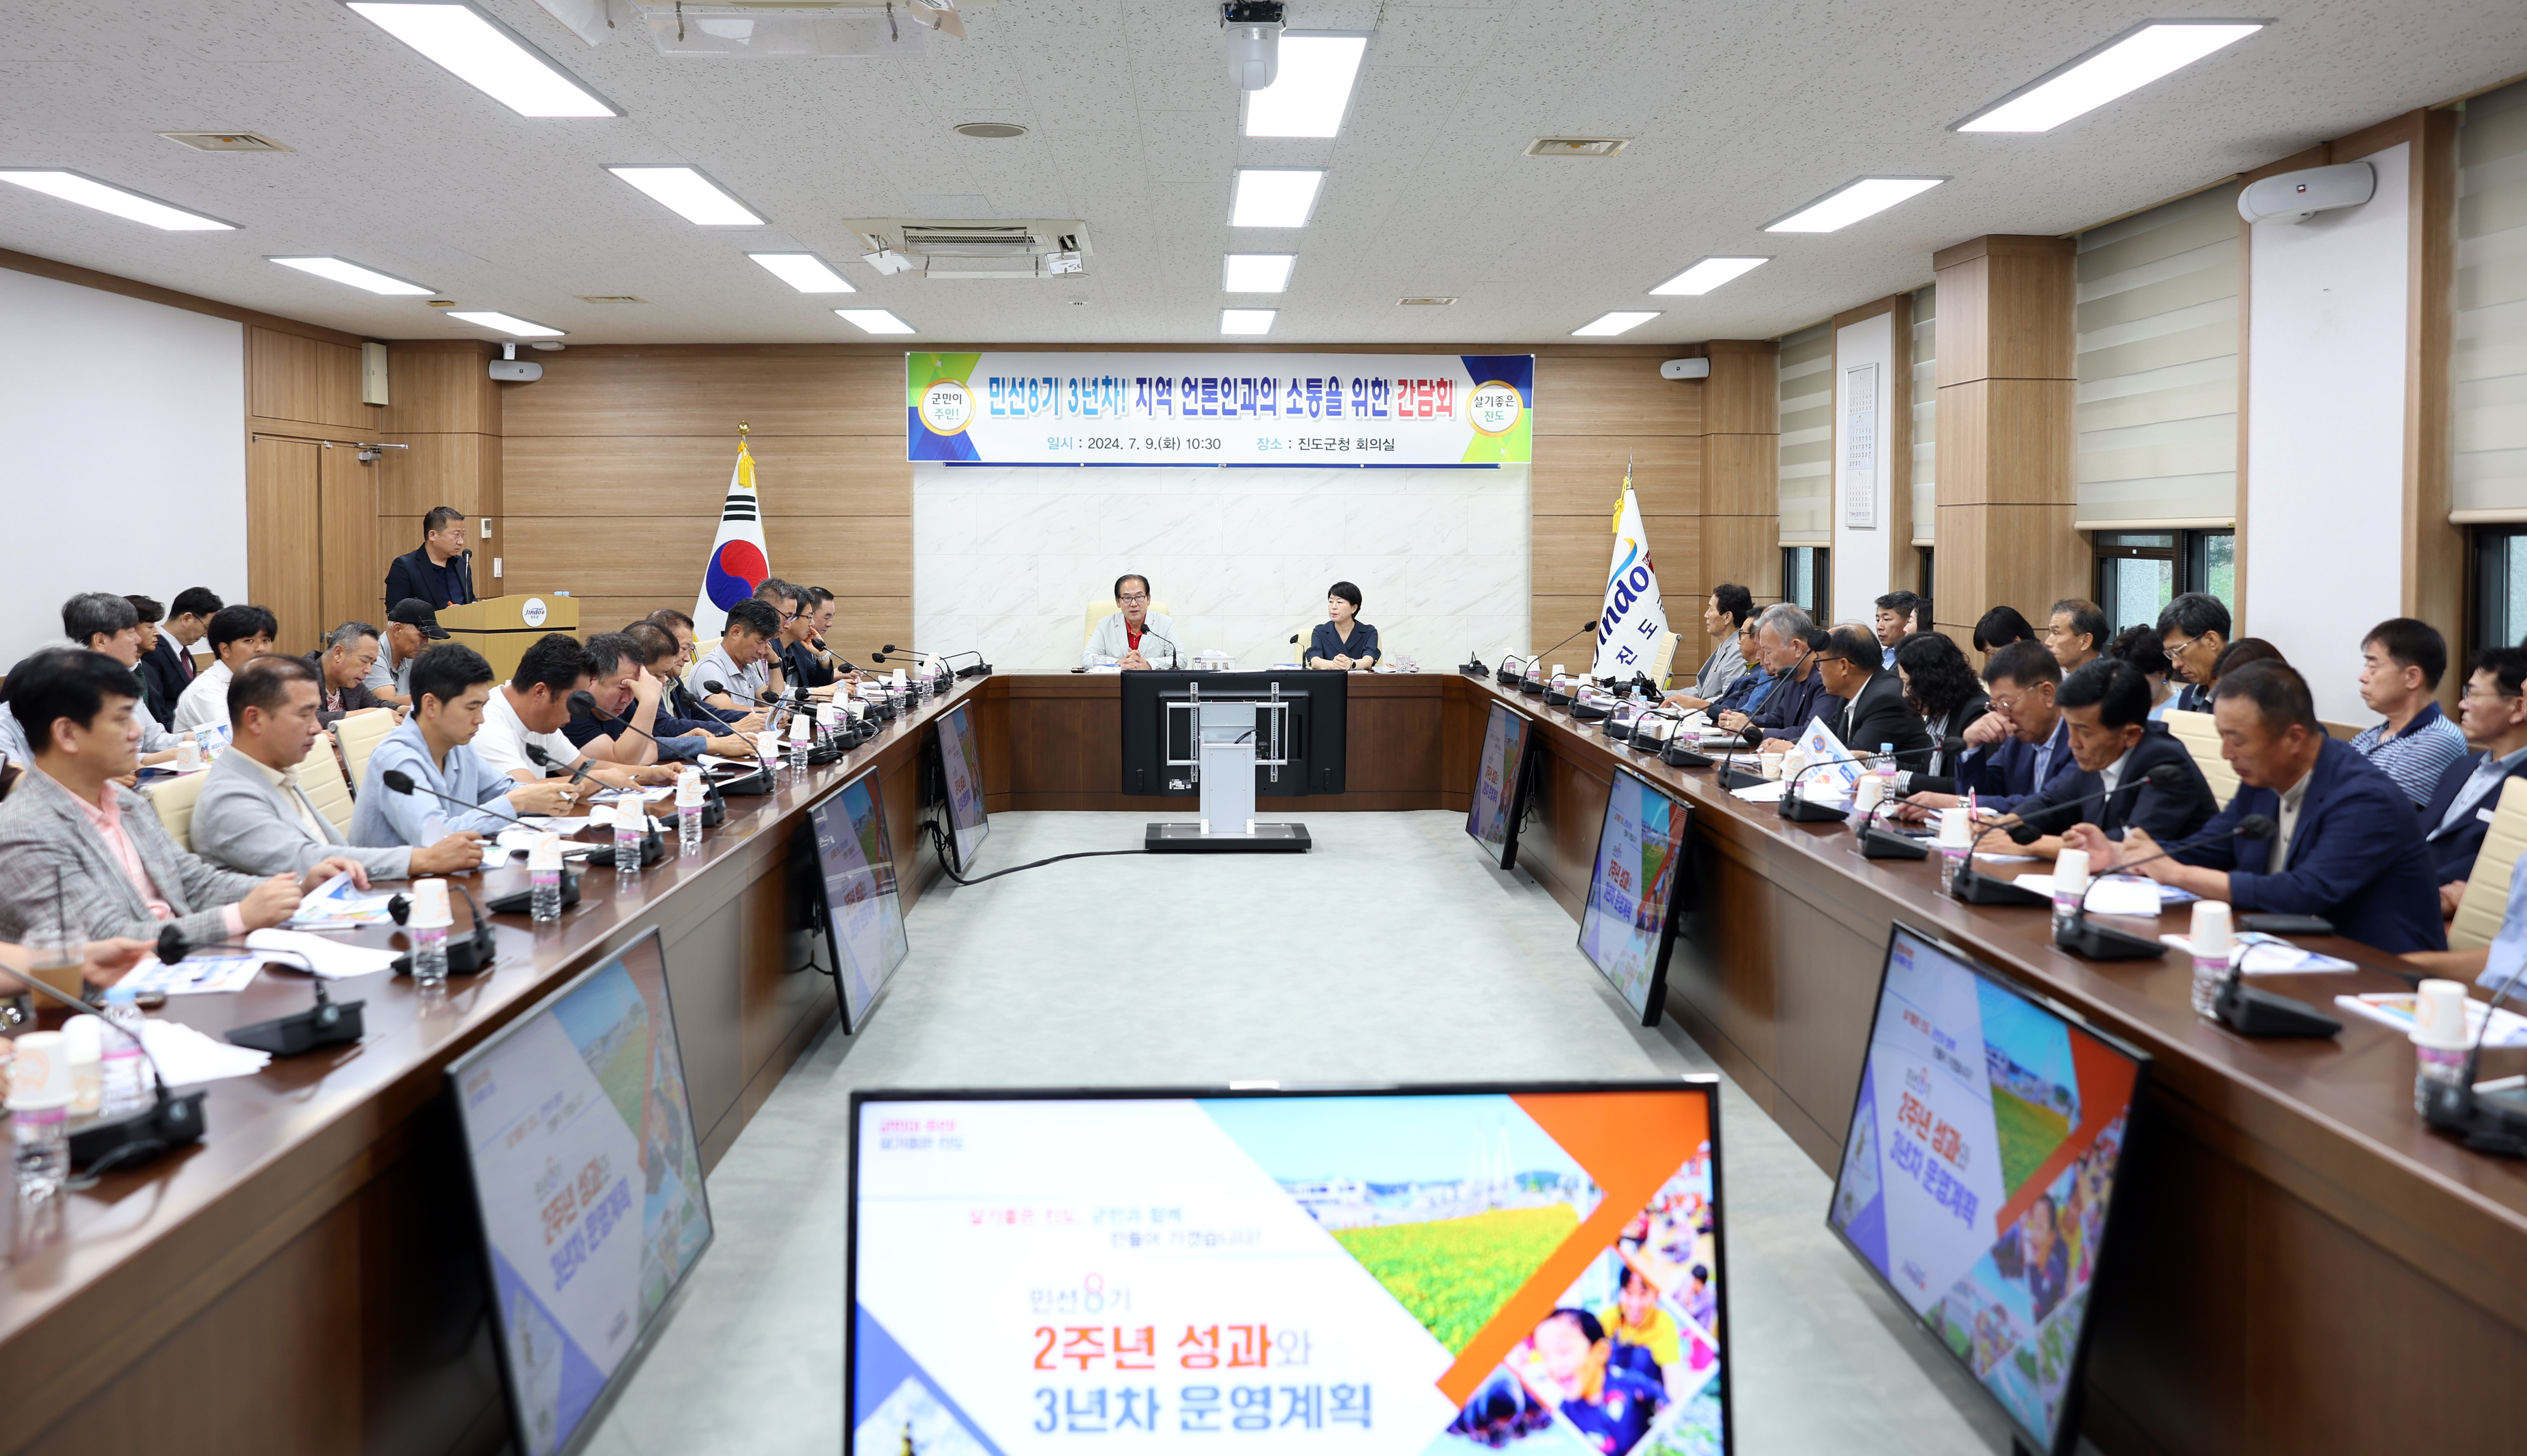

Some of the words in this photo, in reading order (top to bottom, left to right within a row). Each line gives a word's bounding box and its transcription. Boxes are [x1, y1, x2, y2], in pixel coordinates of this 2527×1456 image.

[931, 393, 962, 405] 군민이
[989, 376, 1059, 416] 민선8기
[1068, 375, 1126, 416] 3년차!
[1135, 376, 1172, 416] 지역
[1181, 376, 1277, 417] 언론인과의
[1286, 375, 1343, 419] 소통을
[1351, 377, 1390, 417] 위한
[1397, 377, 1454, 418] 간담회
[1473, 395, 1515, 408] 살기좋은
[934, 408, 958, 420] 주인!
[1484, 410, 1505, 422] 진도
[1047, 436, 1073, 450] 일시
[1087, 438, 1123, 450] 2024.
[1128, 438, 1140, 450] 7.
[1145, 436, 1180, 451] 9.(화)
[1185, 438, 1222, 450] 10:30
[1257, 438, 1283, 451] 장소
[1297, 438, 1350, 452] 진도군청
[1355, 438, 1395, 452] 회의실
[1033, 1324, 1156, 1371] 2주년
[1177, 1323, 1312, 1369] 성과와
[1032, 1385, 1161, 1434] 3년차
[1178, 1381, 1373, 1433] 운영계획
